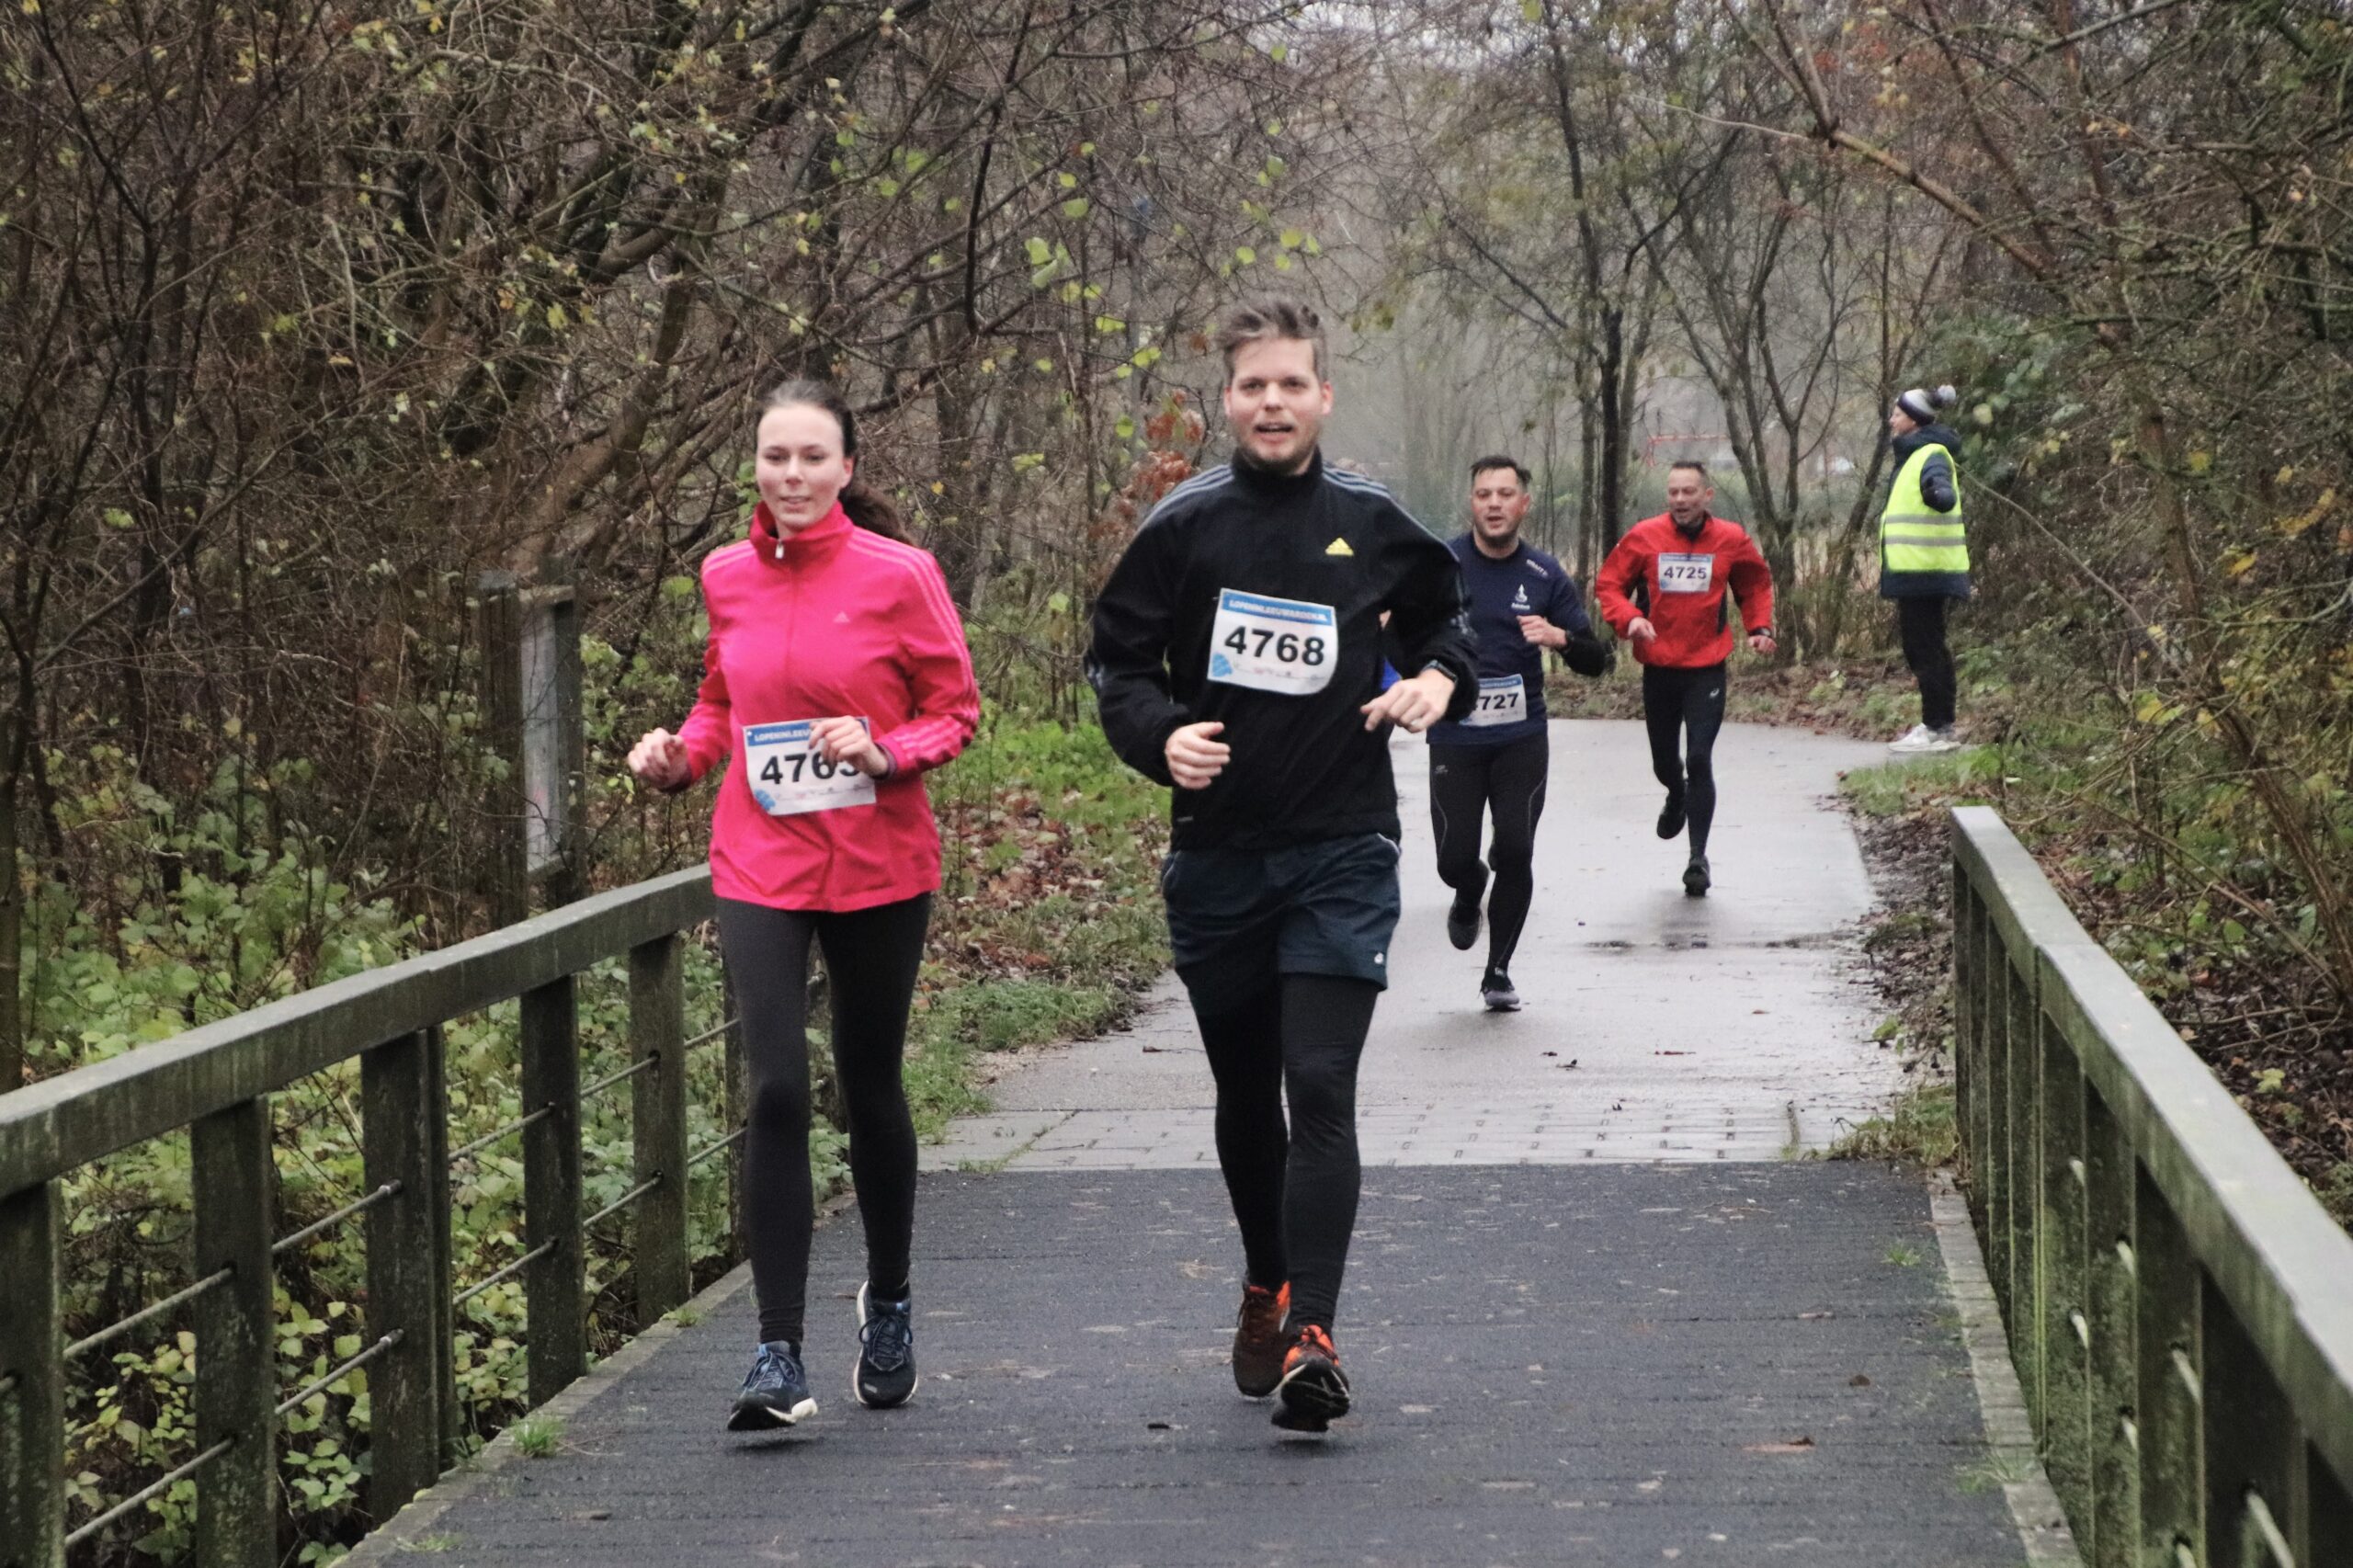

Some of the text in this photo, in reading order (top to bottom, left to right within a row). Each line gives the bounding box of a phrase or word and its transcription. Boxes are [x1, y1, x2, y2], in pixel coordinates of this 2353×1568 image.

[1664, 565, 1707, 580] 4725
[1224, 626, 1324, 666] 4768
[1476, 692, 1519, 710] 727
